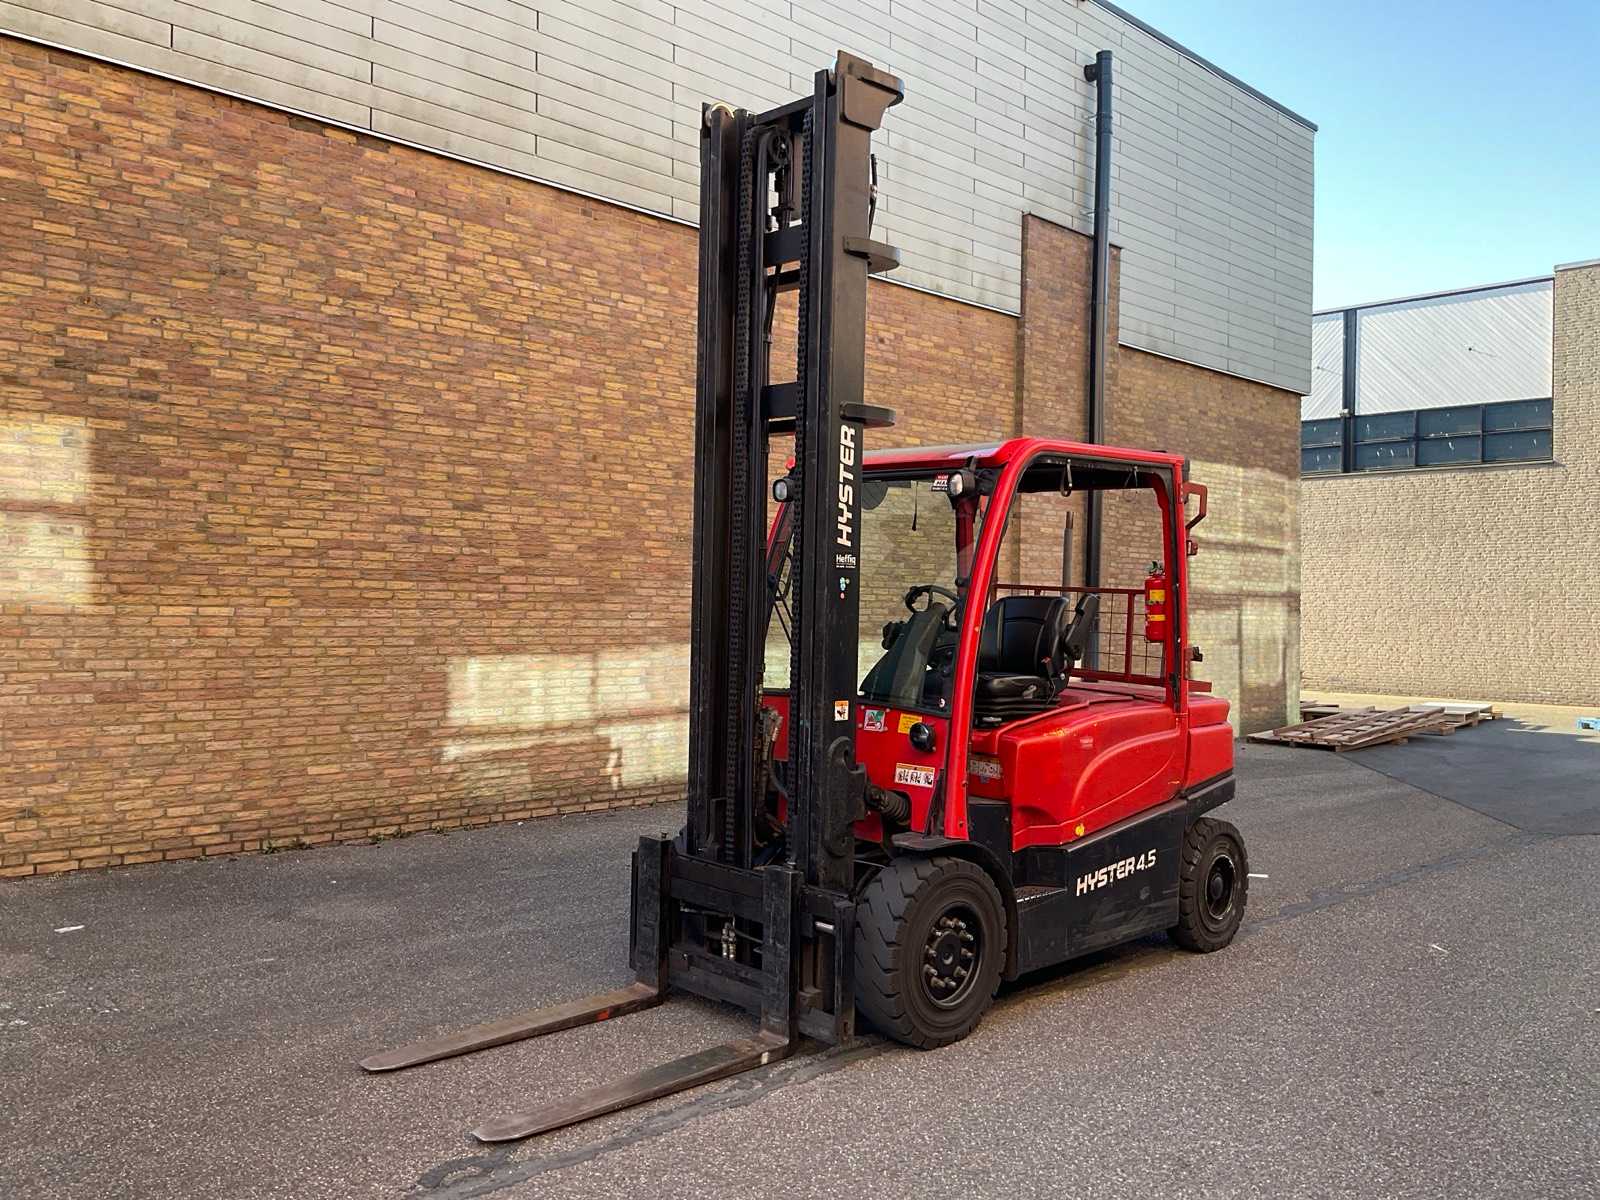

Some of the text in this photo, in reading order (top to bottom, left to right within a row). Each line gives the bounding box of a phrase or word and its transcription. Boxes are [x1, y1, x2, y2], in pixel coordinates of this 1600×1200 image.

[837, 424, 856, 547] HYSTER
[1076, 849, 1157, 896] HYSTER 4.5
